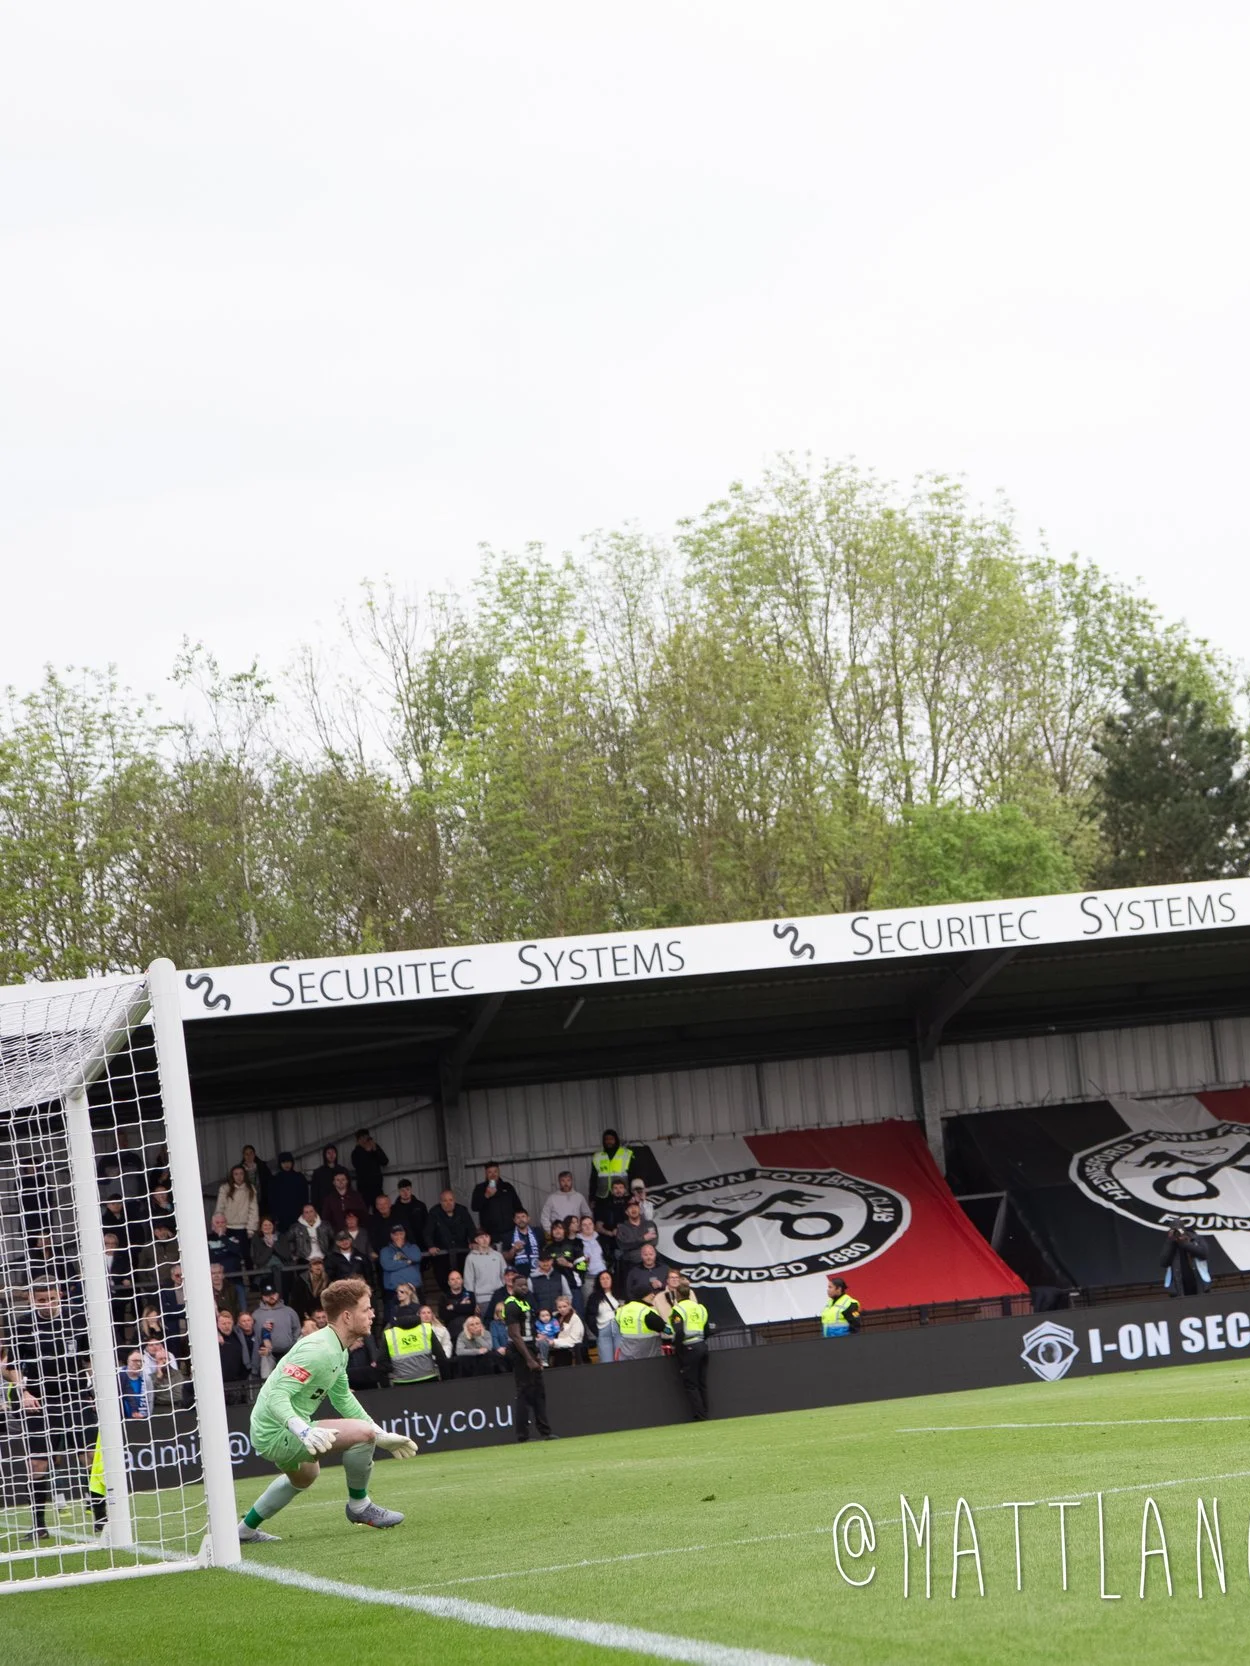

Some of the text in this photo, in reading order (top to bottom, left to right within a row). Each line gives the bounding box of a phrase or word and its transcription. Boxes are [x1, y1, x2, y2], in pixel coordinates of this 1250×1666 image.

[851, 893, 1236, 956] SECURITEC SYSTEMS
[269, 940, 685, 1007] SECURITEC SYSTEMS
[1131, 1130, 1208, 1143] TOWN
[667, 1172, 748, 1197] TOWN
[818, 1243, 872, 1268] 1880
[1088, 1320, 1171, 1364] I-ON
